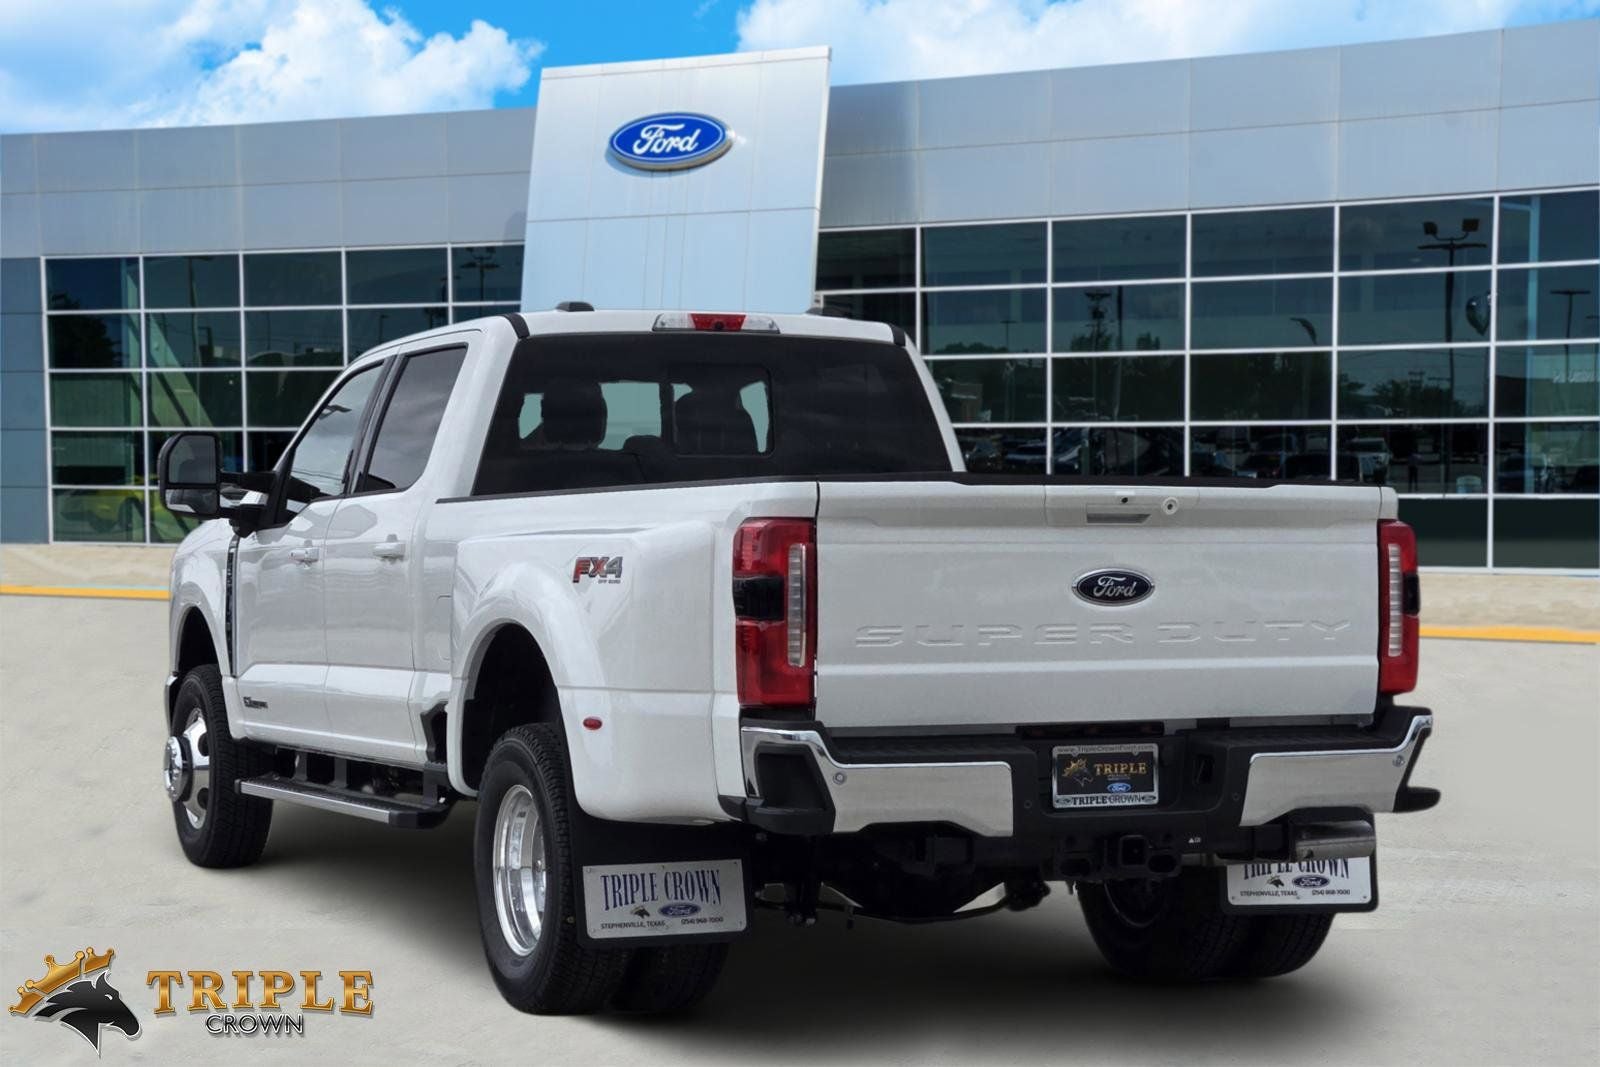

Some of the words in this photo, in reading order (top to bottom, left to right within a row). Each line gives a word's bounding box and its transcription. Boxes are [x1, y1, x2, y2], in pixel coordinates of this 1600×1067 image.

[632, 123, 702, 155] Ford
[572, 556, 623, 584] FX4
[1093, 575, 1138, 600] Ford
[854, 622, 1134, 648] SUPER
[1156, 619, 1351, 644] DUTY
[1094, 762, 1147, 776] TRIPLE
[1072, 795, 1107, 806] TRIPLE
[1108, 794, 1141, 804] CROWN
[601, 872, 659, 911] TRIPLE
[664, 869, 721, 905] CROWN
[600, 920, 646, 930] STEPHENVILLE,
[647, 919, 666, 928] TEXAS
